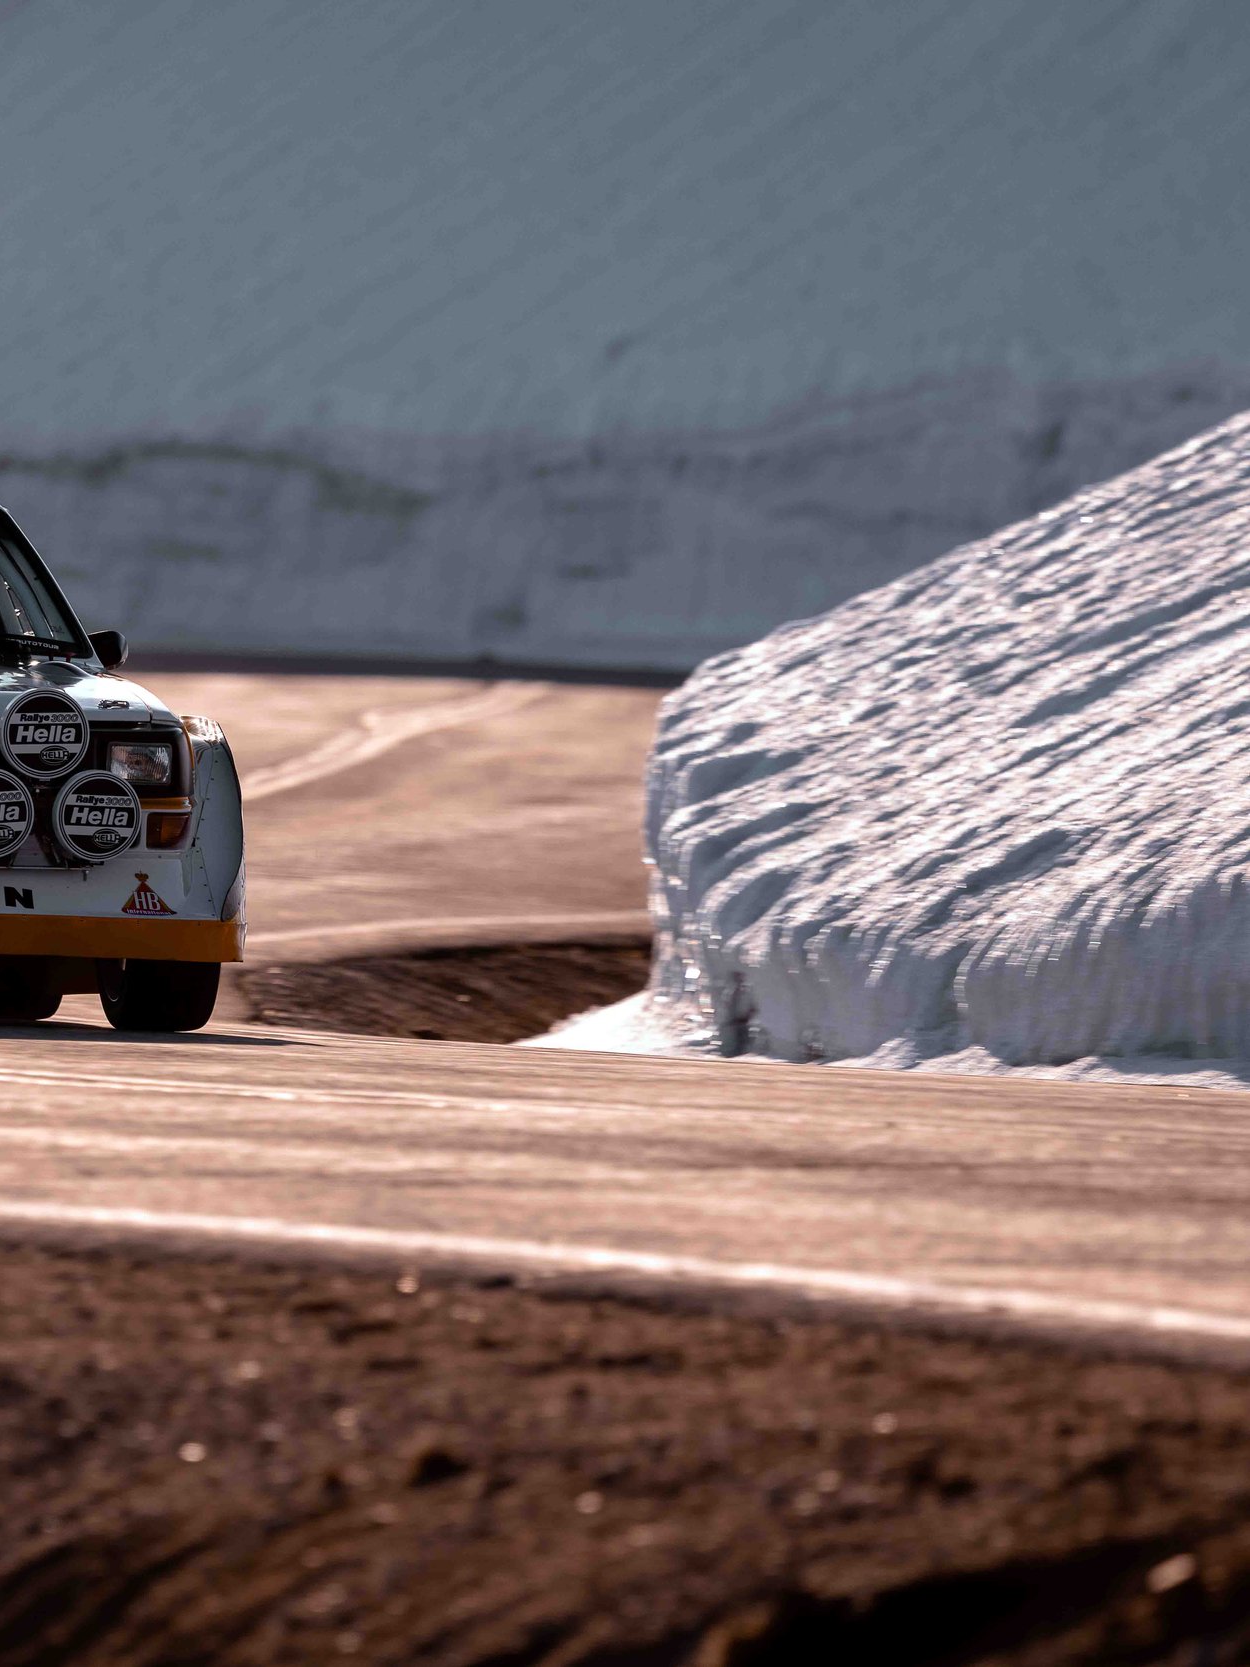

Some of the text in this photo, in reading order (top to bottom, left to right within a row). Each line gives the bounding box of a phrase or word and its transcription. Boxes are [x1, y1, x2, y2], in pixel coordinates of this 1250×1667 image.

[20, 714, 79, 723] Rallye 3000
[16, 725, 76, 743] Hella
[76, 795, 132, 806] Rallye 3000
[70, 807, 129, 826] Hella
[133, 892, 161, 910] HB
